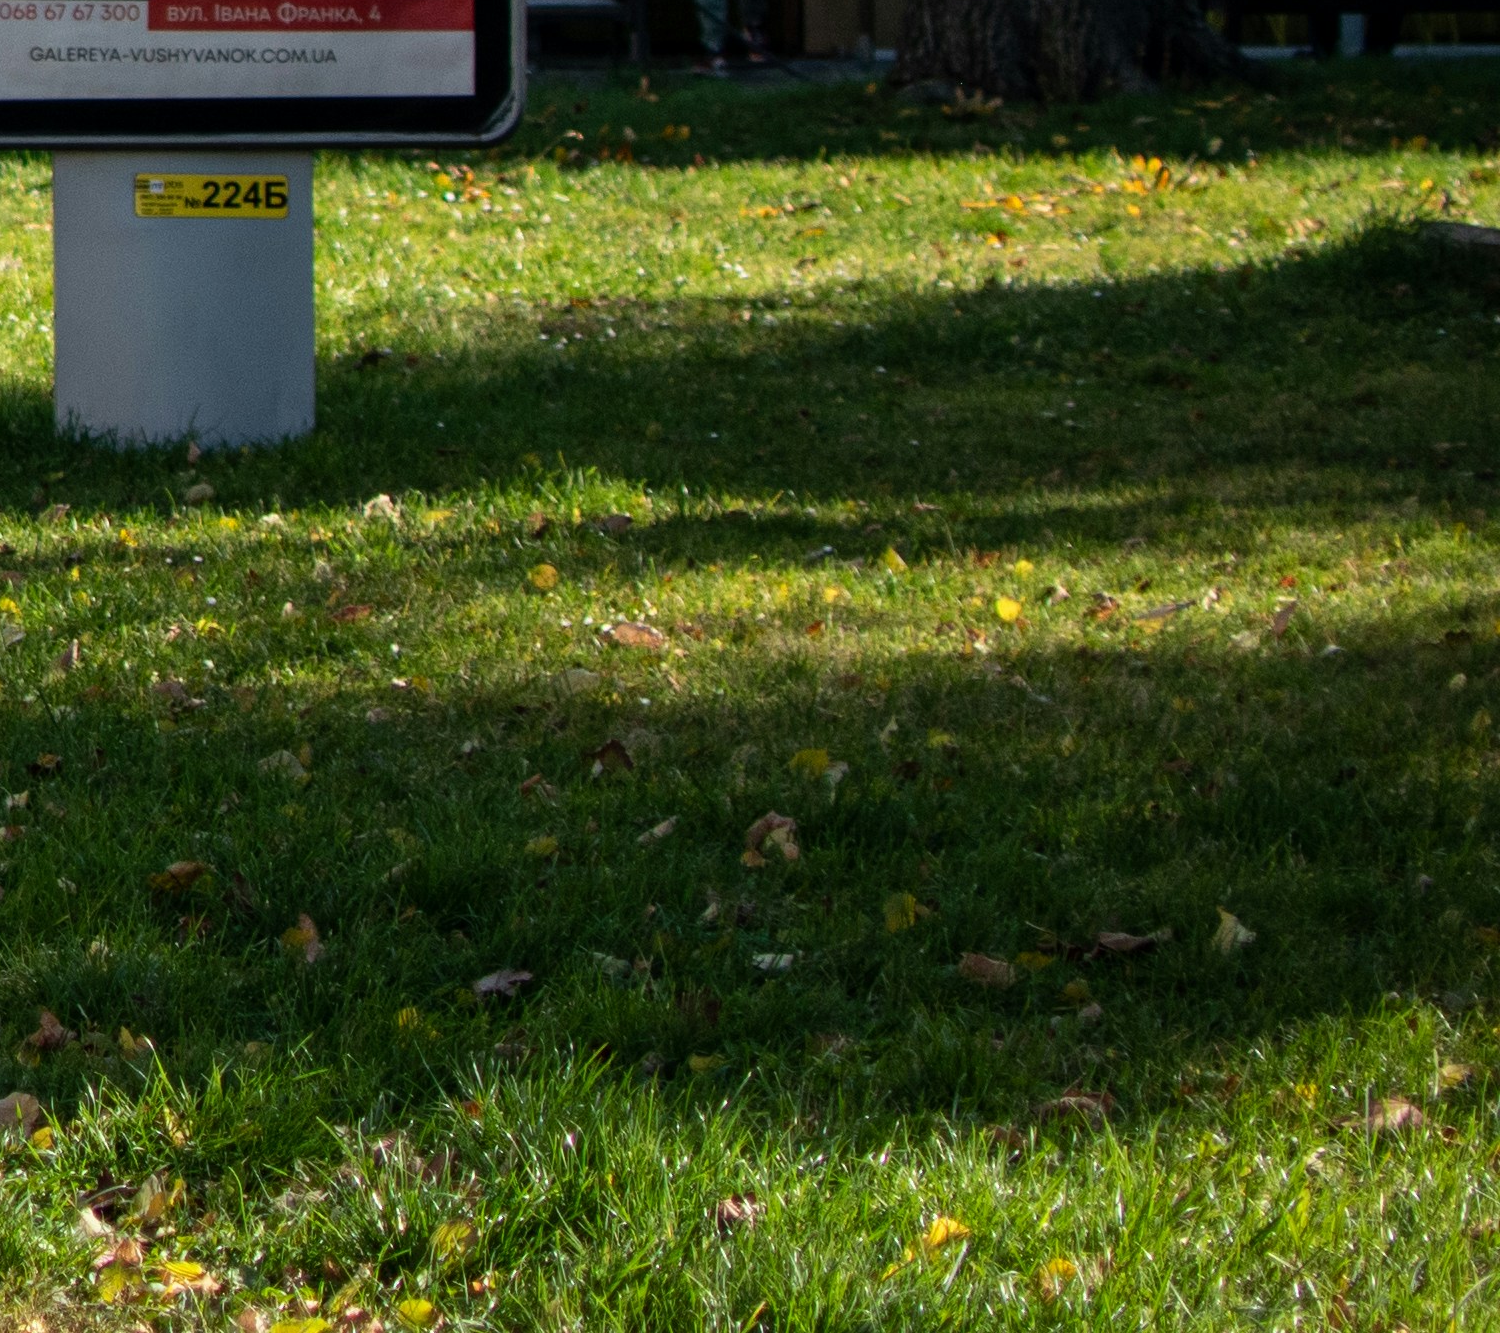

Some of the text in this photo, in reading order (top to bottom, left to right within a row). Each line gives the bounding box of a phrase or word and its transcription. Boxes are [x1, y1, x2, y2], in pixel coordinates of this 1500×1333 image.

[0, 3, 38, 21] 068
[44, 3, 68, 21] 67
[73, 3, 96, 21] 67
[101, 3, 141, 22] 300
[369, 6, 382, 22] 4
[29, 45, 338, 64] GALEREYA-VUSHYVANOK.COM.UA
